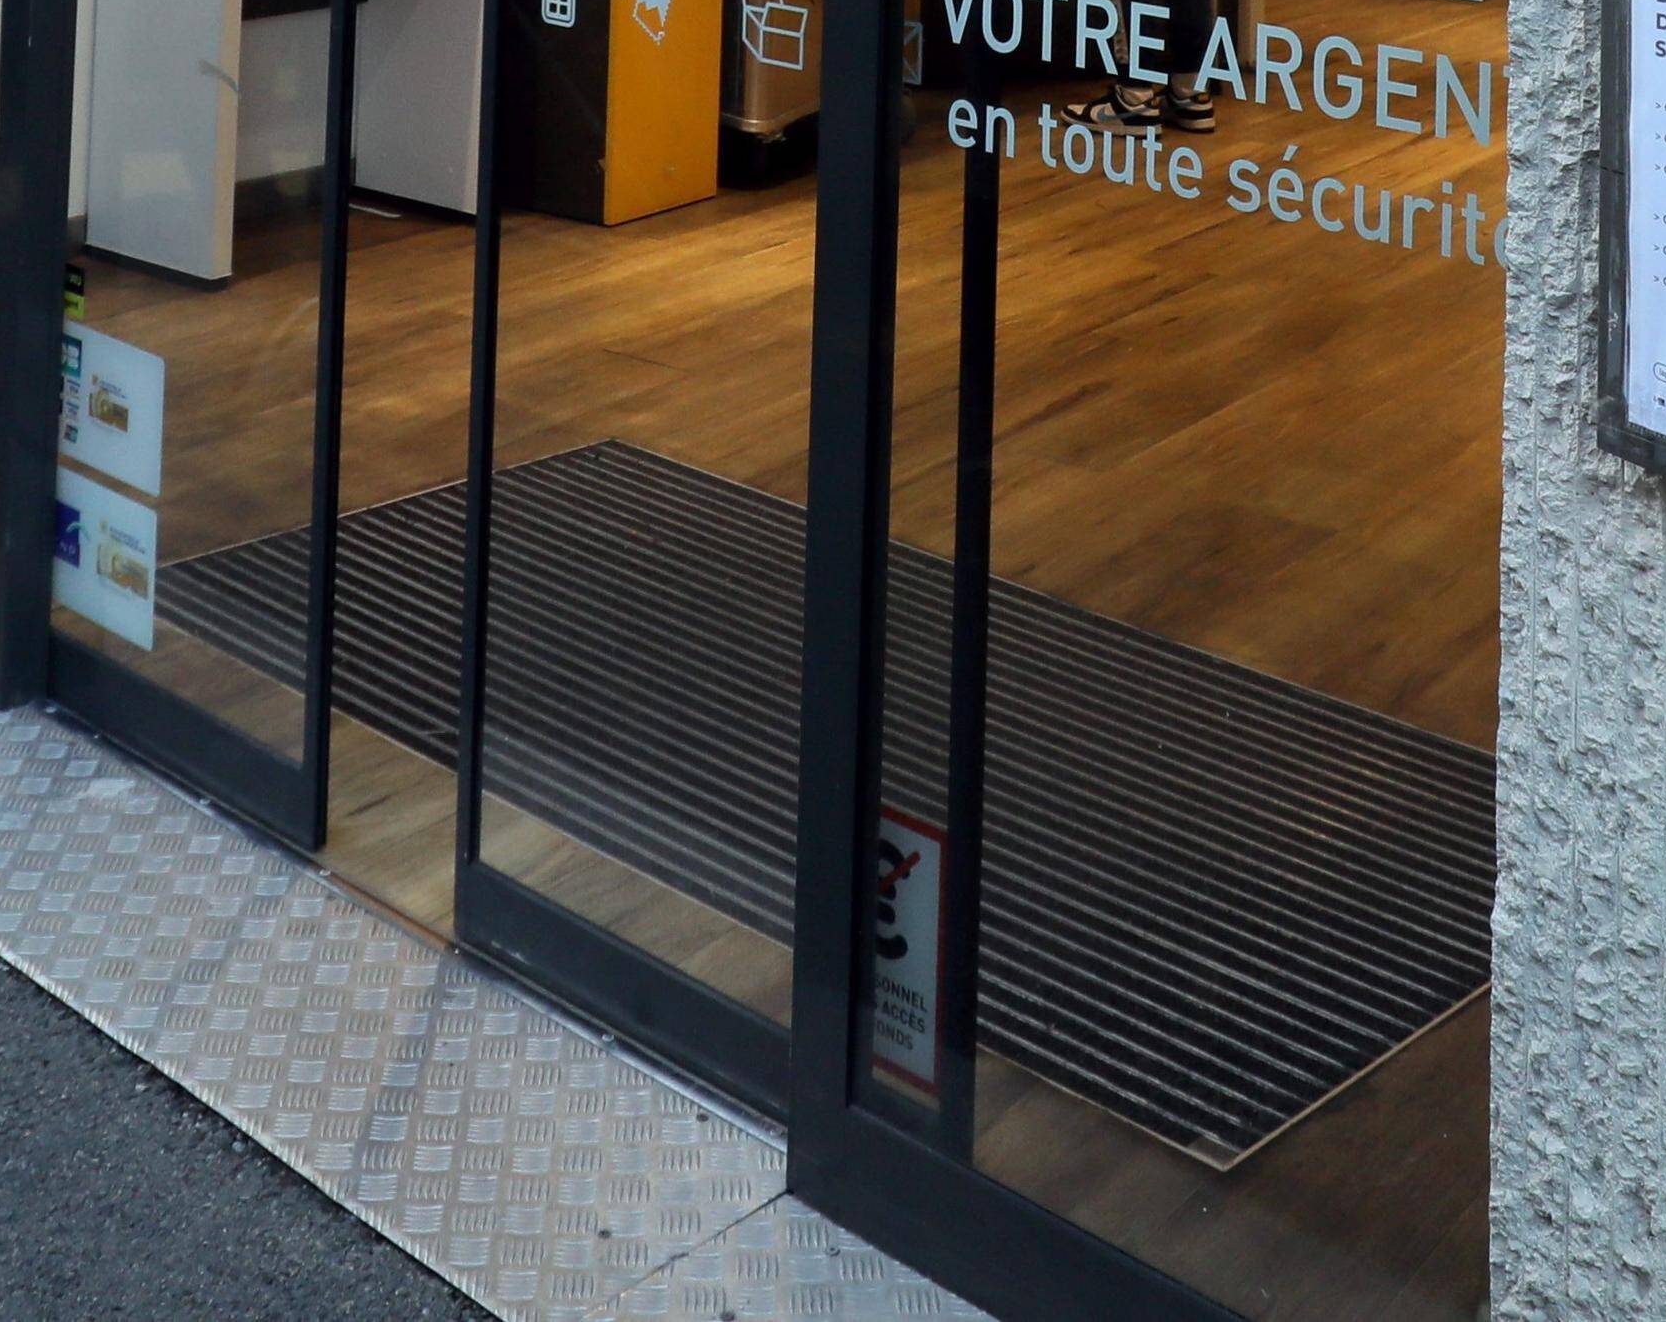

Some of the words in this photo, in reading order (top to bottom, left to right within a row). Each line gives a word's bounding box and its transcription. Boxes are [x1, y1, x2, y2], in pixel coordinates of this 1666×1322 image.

[1194, 14, 1511, 148] ARGEN
[948, 97, 1017, 159] en
[1039, 100, 1203, 200] toute
[876, 1019, 913, 1050] ONDS
[883, 999, 925, 1034] ACCÈS
